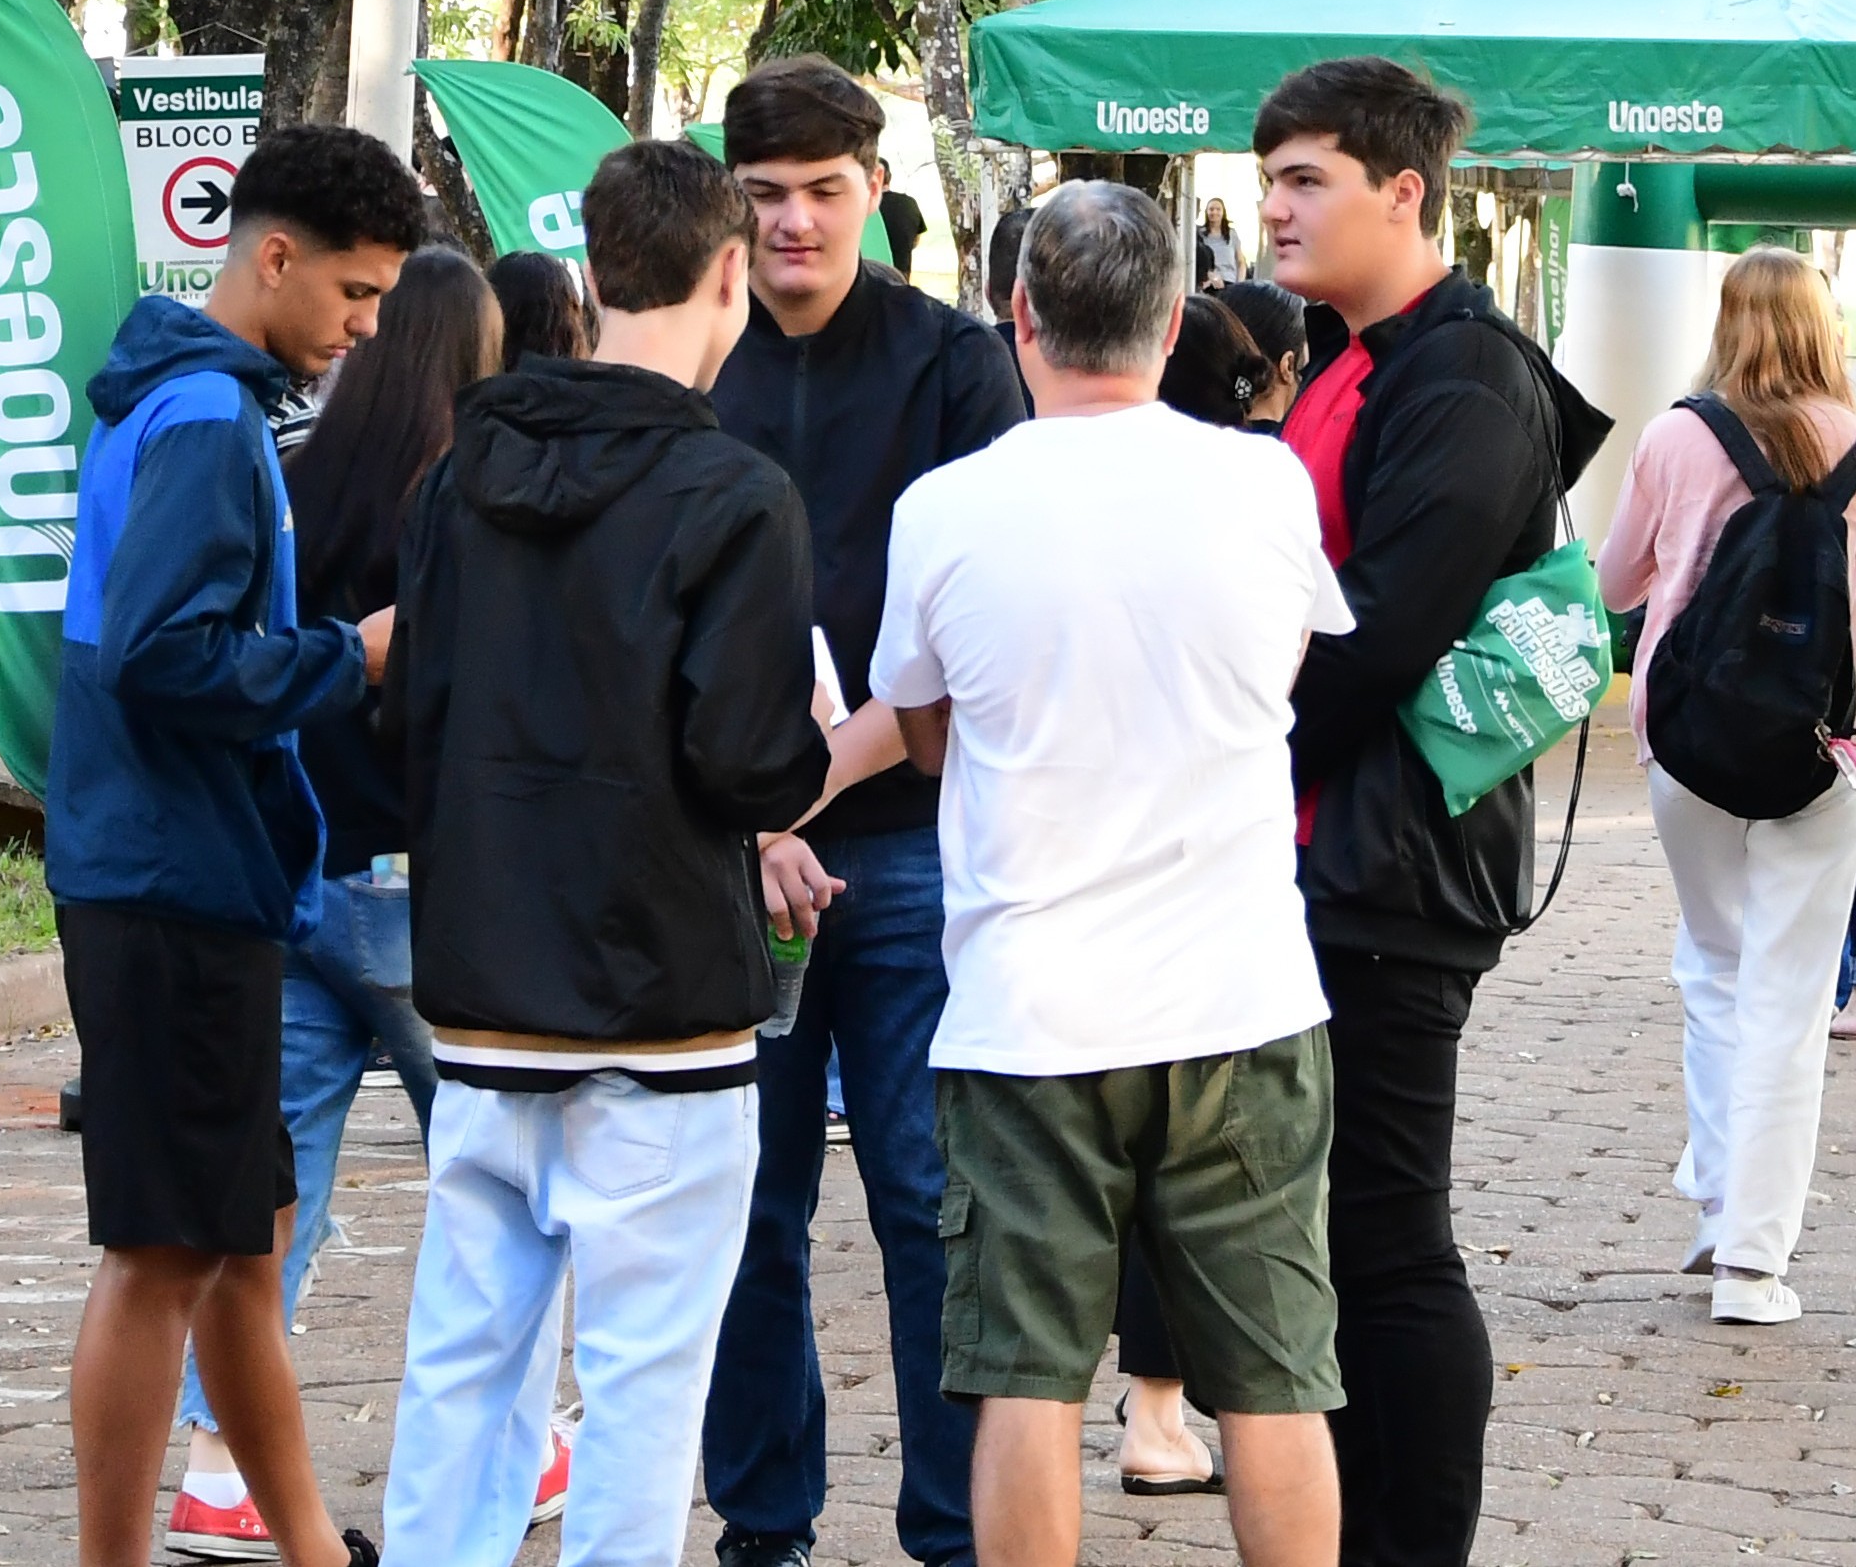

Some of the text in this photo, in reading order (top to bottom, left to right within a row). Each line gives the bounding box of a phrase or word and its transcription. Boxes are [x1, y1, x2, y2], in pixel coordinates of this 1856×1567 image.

[133, 86, 263, 112] Vestibula
[1096, 100, 1210, 134] Unoeste
[1608, 100, 1724, 134] Unoeste
[136, 125, 258, 148] BLOCO B
[1515, 596, 1601, 695] FEIRA DE
[1435, 653, 1478, 734] Unoeste
